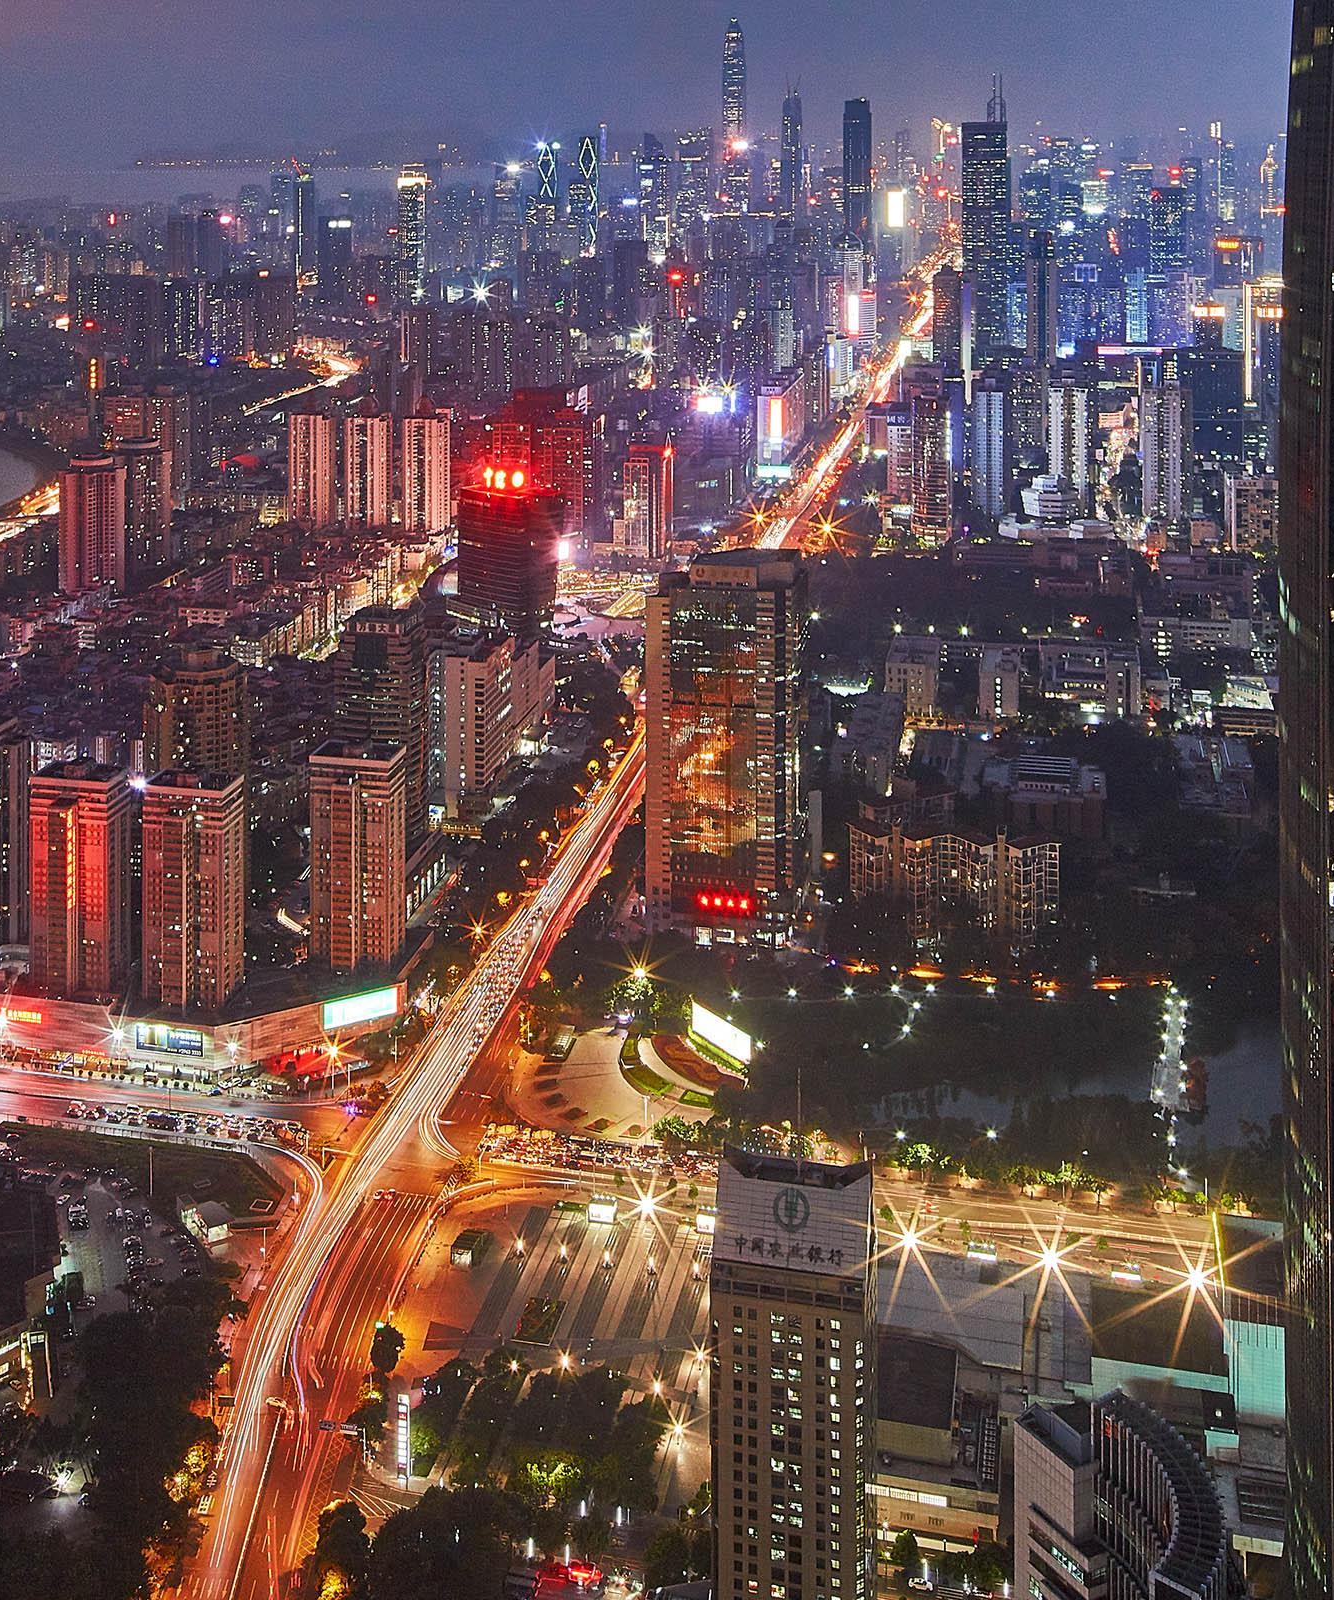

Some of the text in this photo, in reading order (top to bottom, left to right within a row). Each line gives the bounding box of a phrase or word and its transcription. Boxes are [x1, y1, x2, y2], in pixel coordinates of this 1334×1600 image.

[735, 1234, 844, 1266] 中国农业银行
